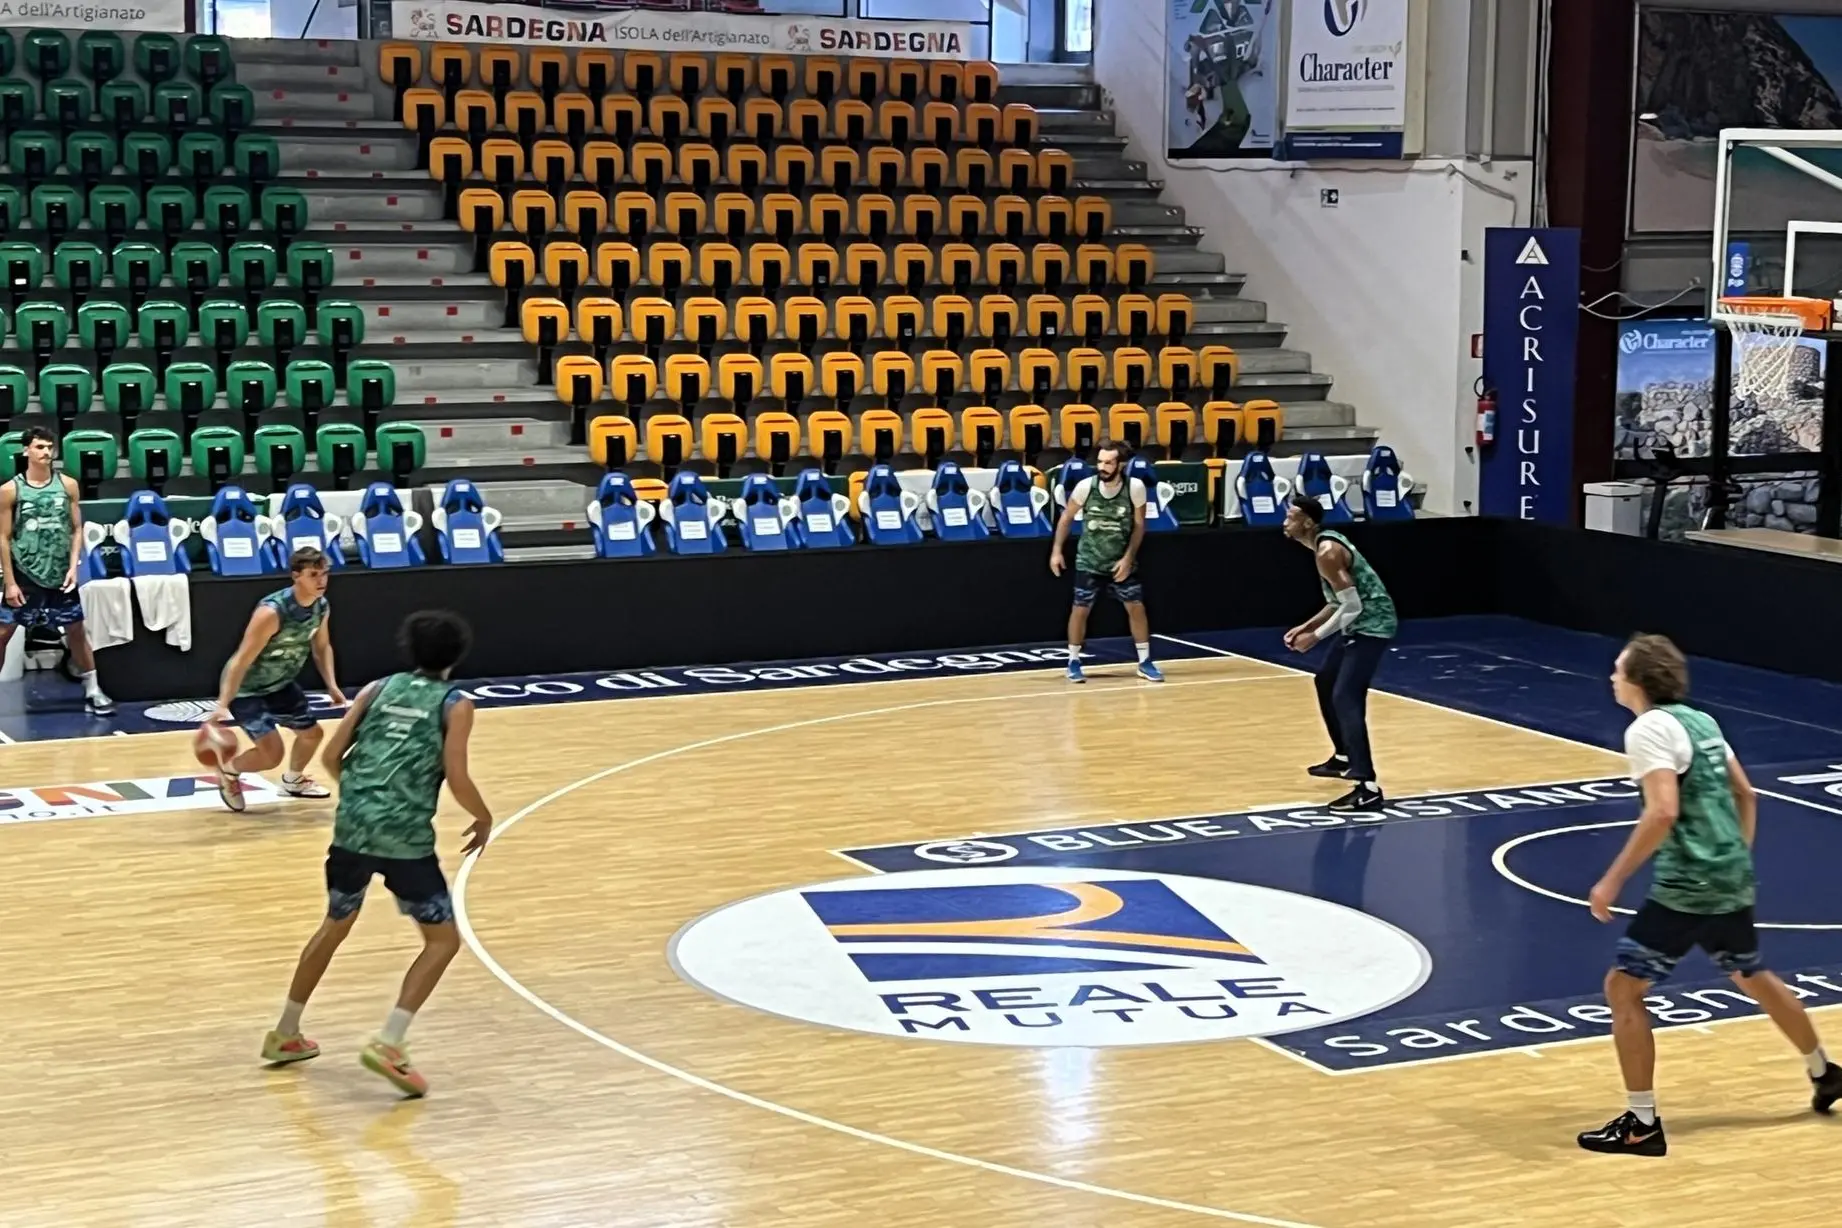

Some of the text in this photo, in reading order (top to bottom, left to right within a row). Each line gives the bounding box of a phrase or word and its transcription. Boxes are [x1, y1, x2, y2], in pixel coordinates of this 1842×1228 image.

[18, 3, 146, 22] dell'Artigianato
[446, 13, 607, 42] SARDEGNA
[614, 26, 659, 40] ISOLA
[820, 28, 961, 53] SARDEGNA
[1300, 52, 1393, 82] Character
[1517, 275, 1545, 520] ACRISURE
[595, 672, 683, 691] di
[683, 647, 1096, 684] Sardegna
[1028, 778, 1640, 851] BLUE ASSISTANC
[878, 976, 1307, 1014] REALE
[900, 1001, 1331, 1033] MUTUA
